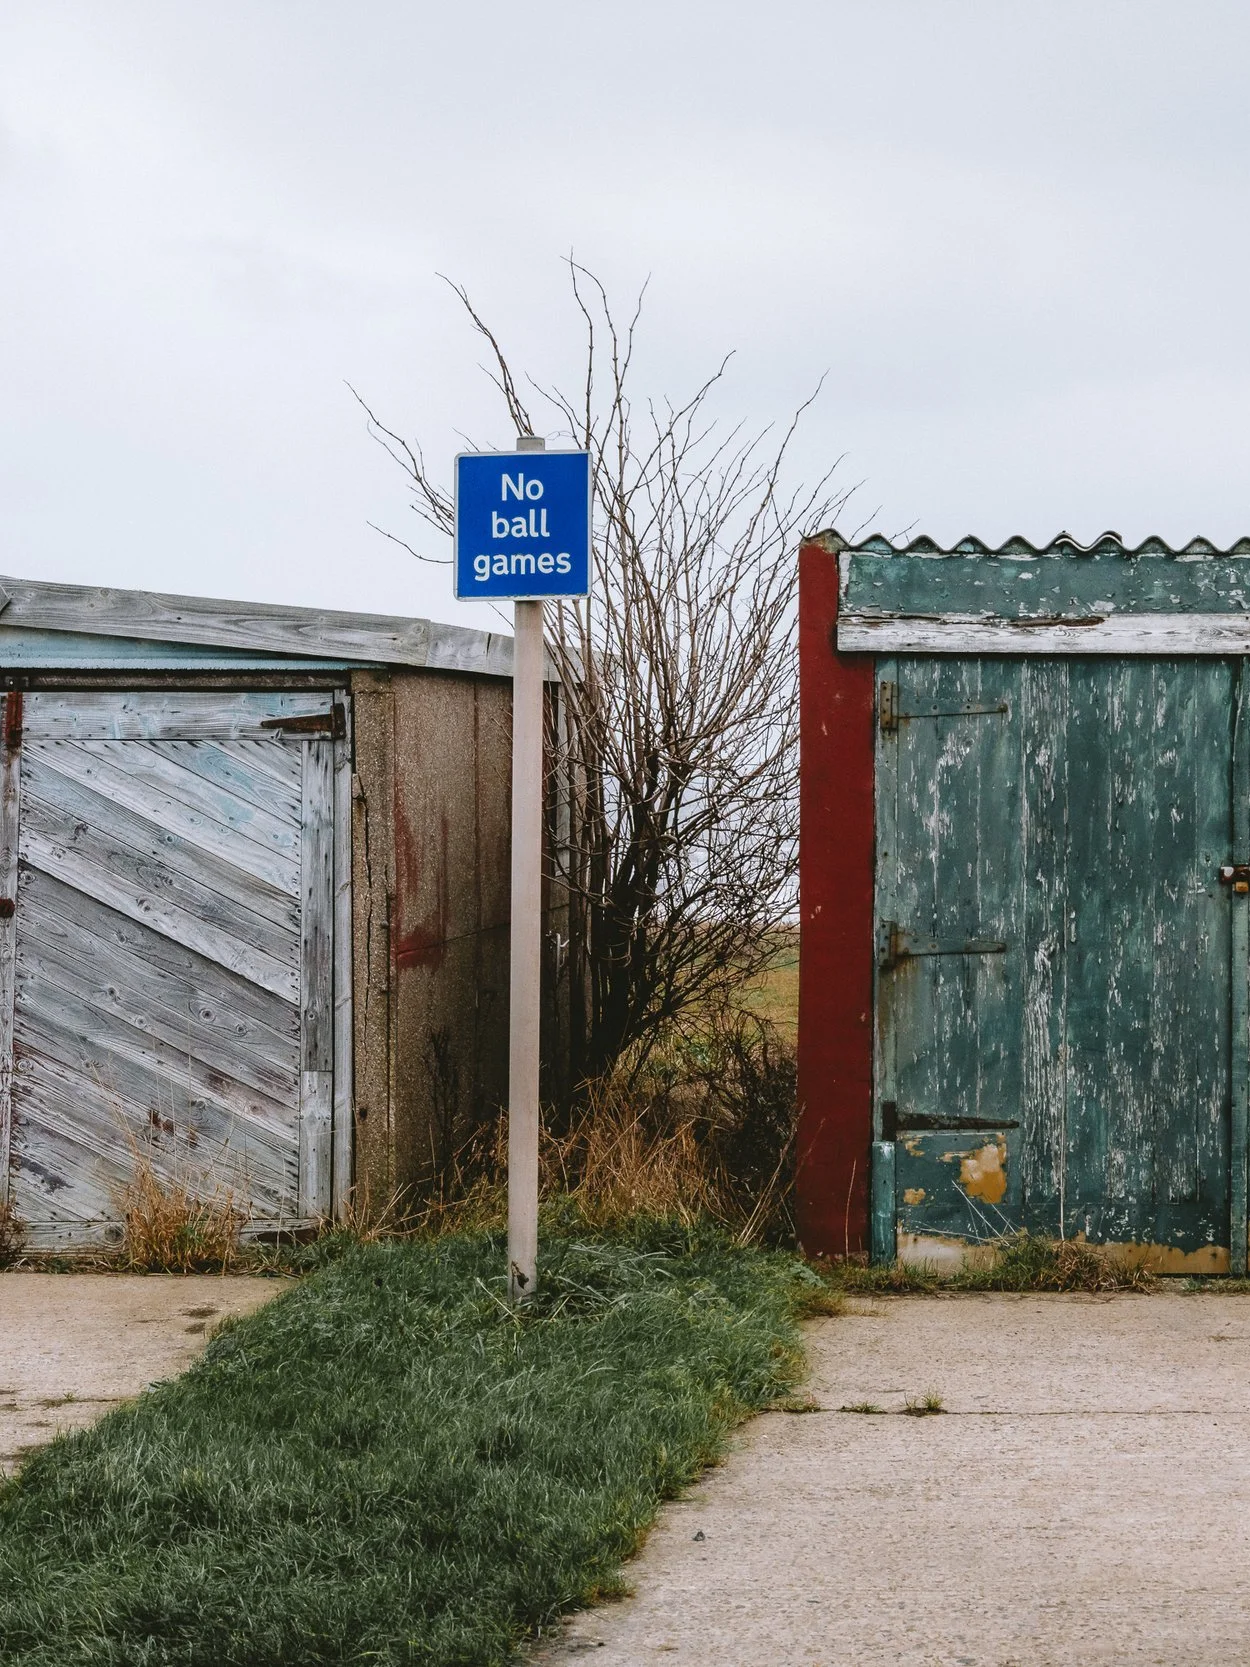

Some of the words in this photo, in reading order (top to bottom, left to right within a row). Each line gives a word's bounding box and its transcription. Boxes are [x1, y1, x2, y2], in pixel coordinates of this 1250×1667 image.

[501, 473, 544, 501] No
[492, 508, 550, 538] ball
[473, 552, 572, 582] games
